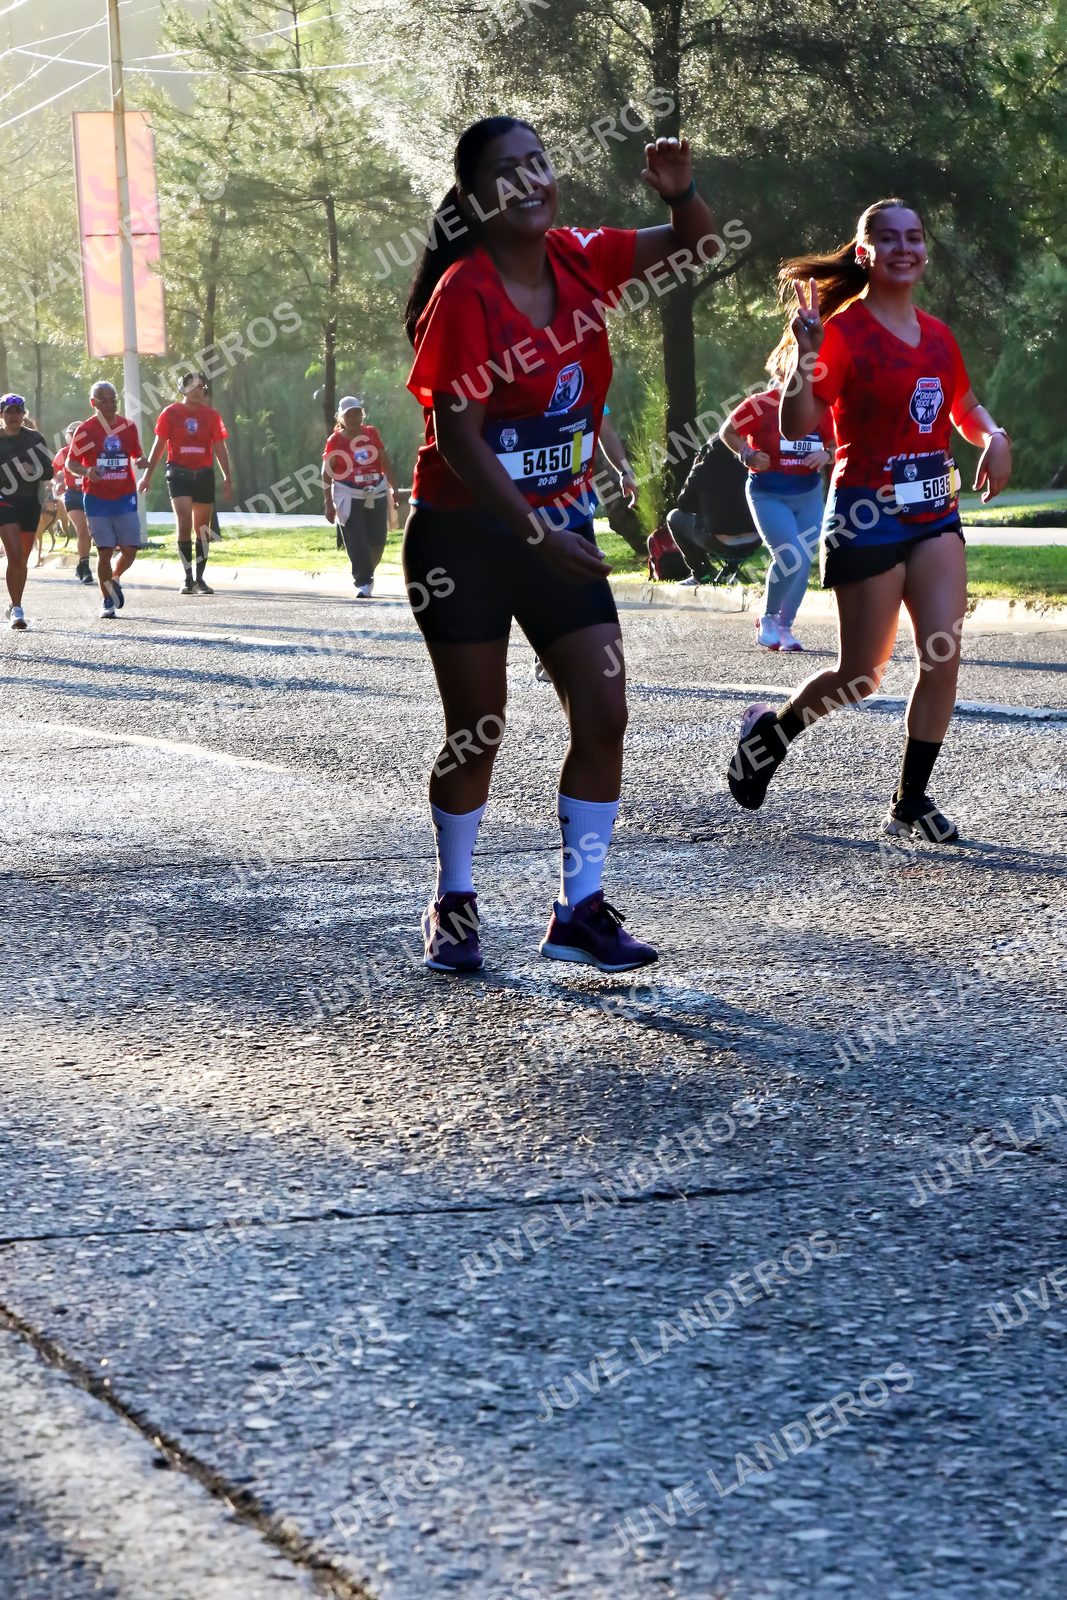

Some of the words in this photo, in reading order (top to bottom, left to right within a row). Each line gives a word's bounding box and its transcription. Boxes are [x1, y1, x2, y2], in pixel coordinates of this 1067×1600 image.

[793, 441, 812, 451] 4900
[522, 444, 571, 476] 5450
[923, 476, 951, 500] 5035
